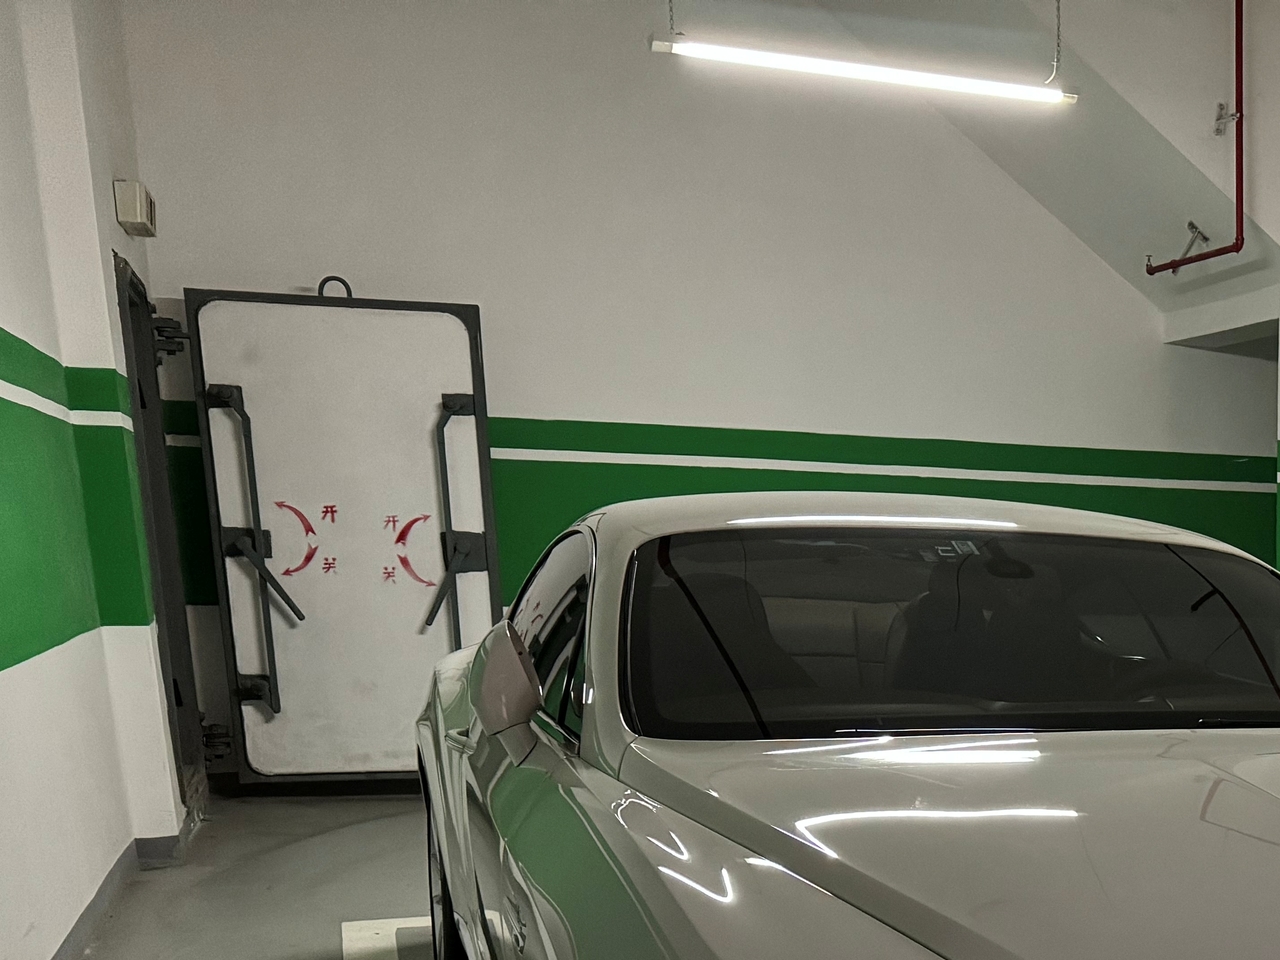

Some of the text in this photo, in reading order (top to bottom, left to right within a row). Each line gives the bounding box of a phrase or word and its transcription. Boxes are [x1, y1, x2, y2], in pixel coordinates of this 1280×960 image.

[321, 505, 338, 523] 开
[383, 515, 399, 532] 开
[321, 557, 338, 575] 关
[382, 566, 397, 584] 关
